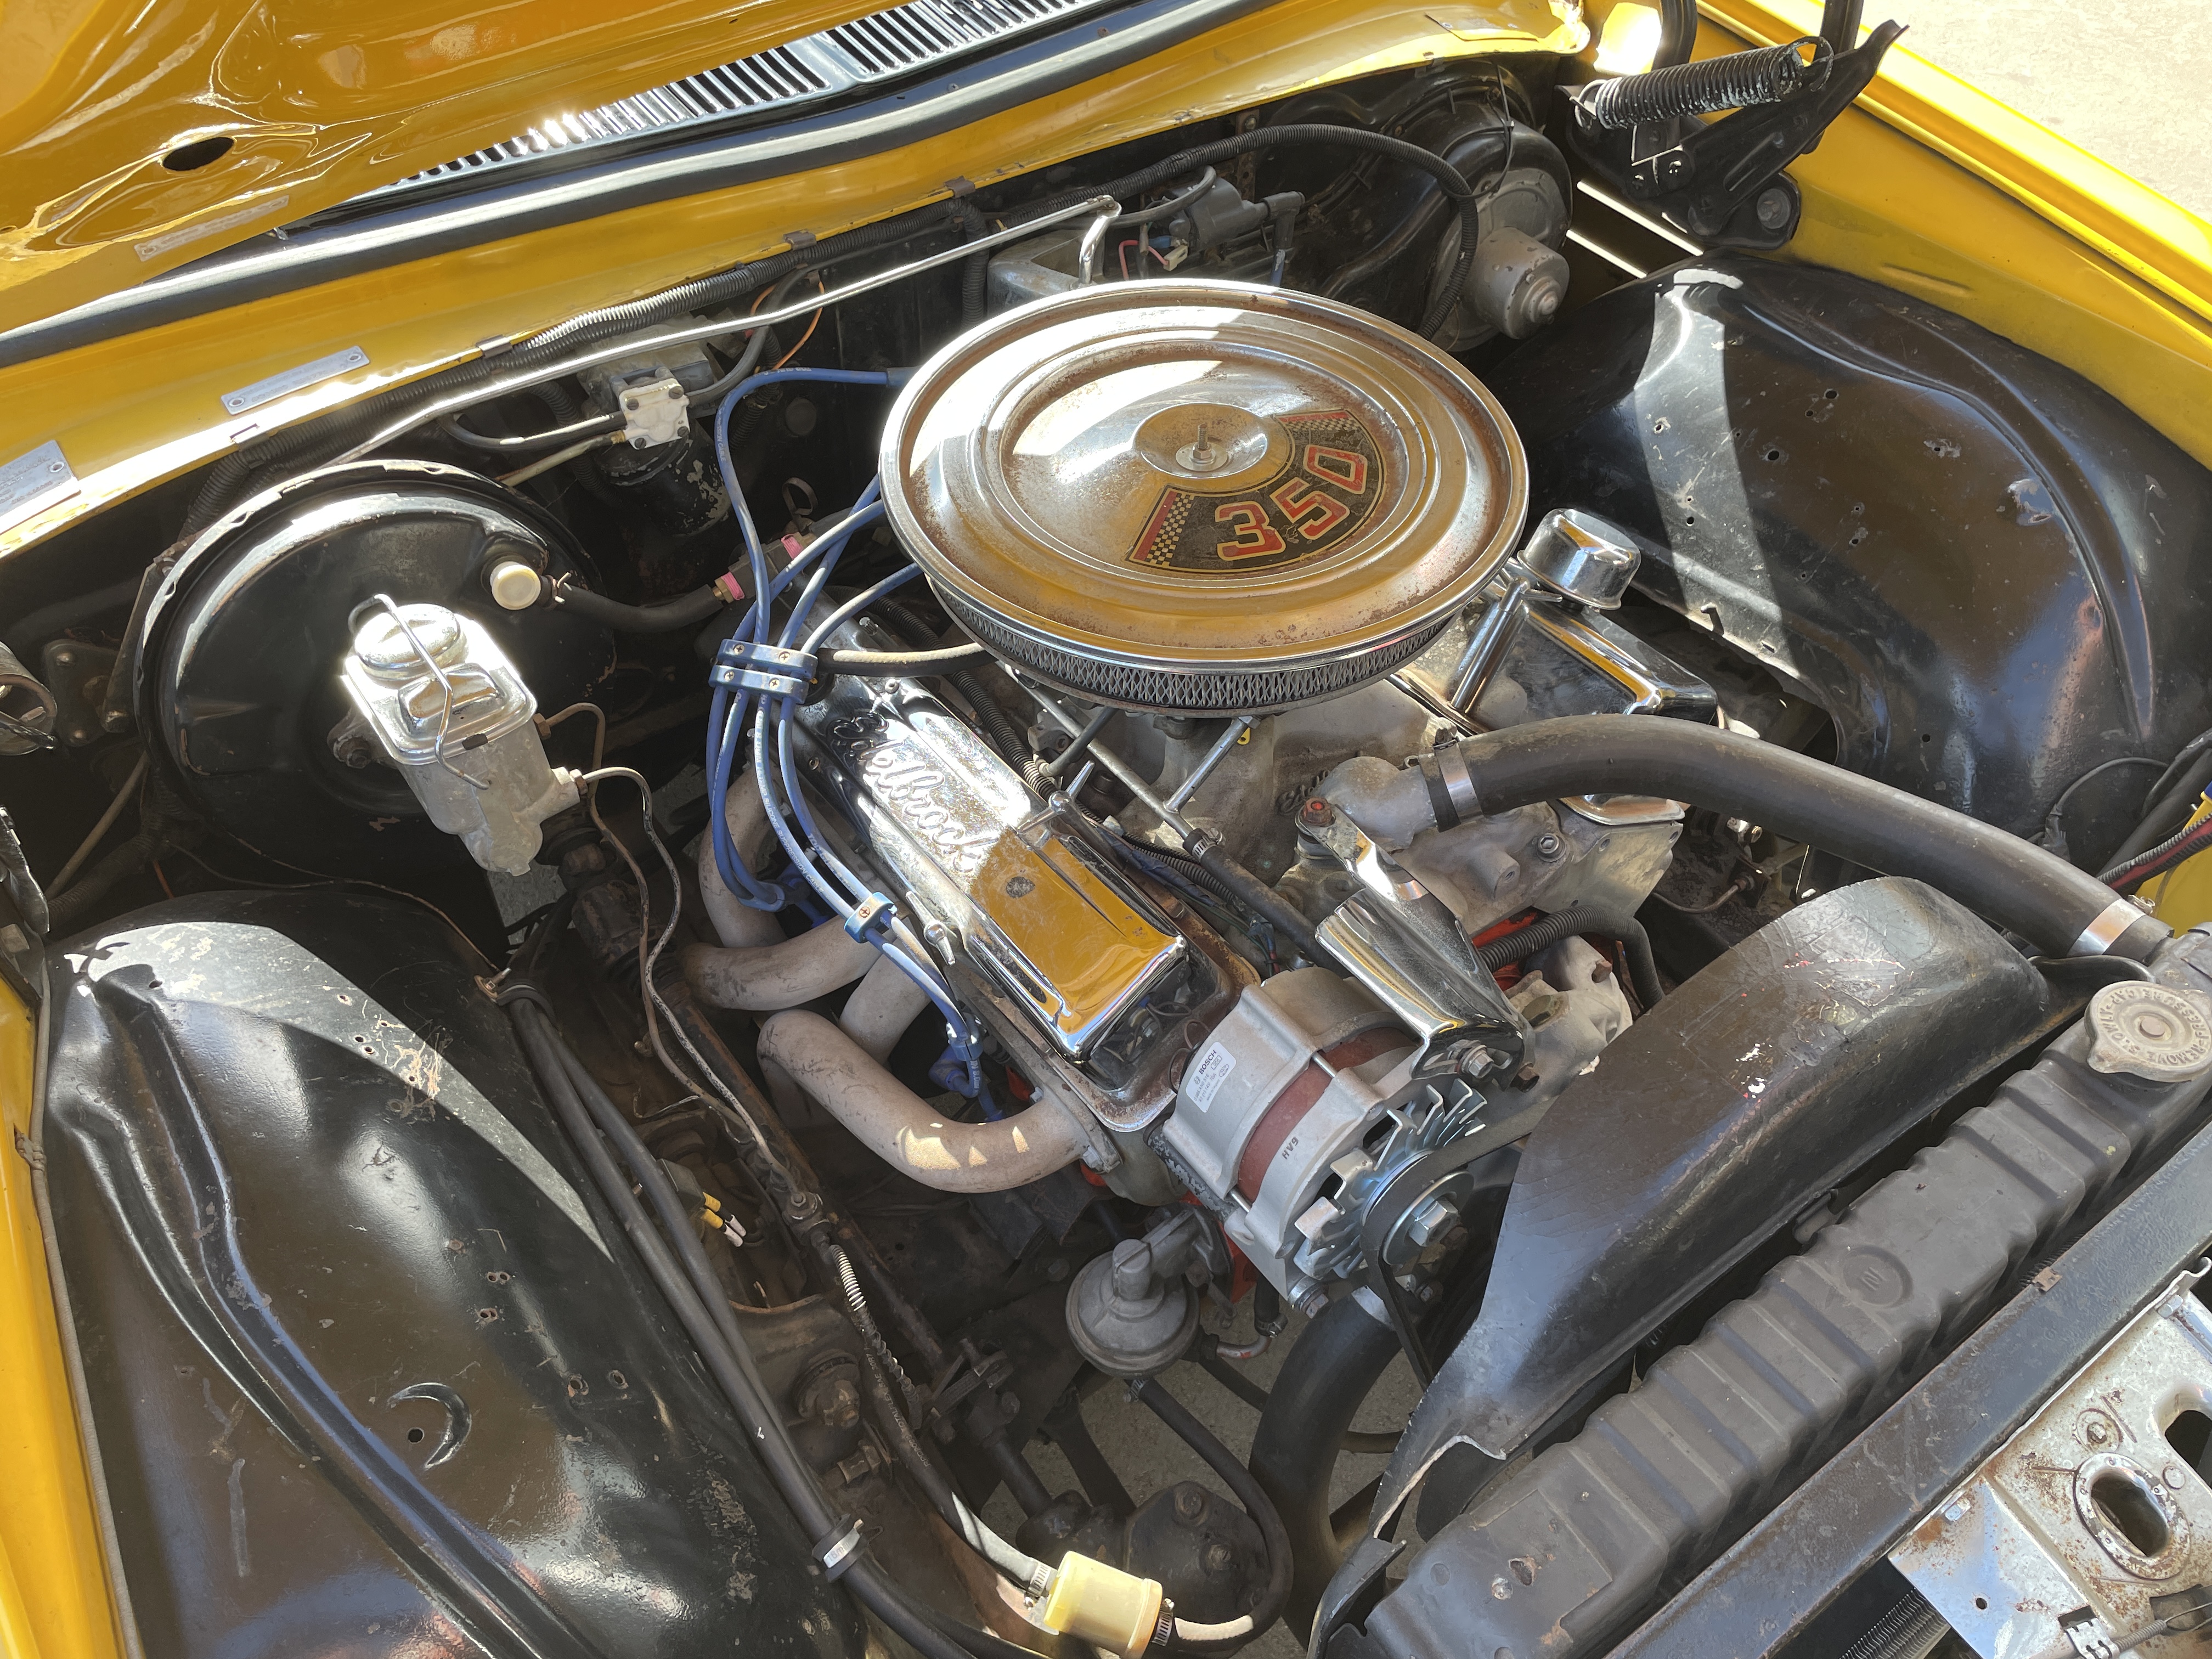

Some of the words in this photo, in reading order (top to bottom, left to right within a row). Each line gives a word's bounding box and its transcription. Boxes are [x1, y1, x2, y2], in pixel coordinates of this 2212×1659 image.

[1215, 444, 1368, 561] 350
[764, 798, 780, 829] SILICONE
[777, 830, 808, 874] SUPPRESSION
[1198, 1049, 1217, 1074] BOSCH
[874, 1373, 885, 1389] SAE
